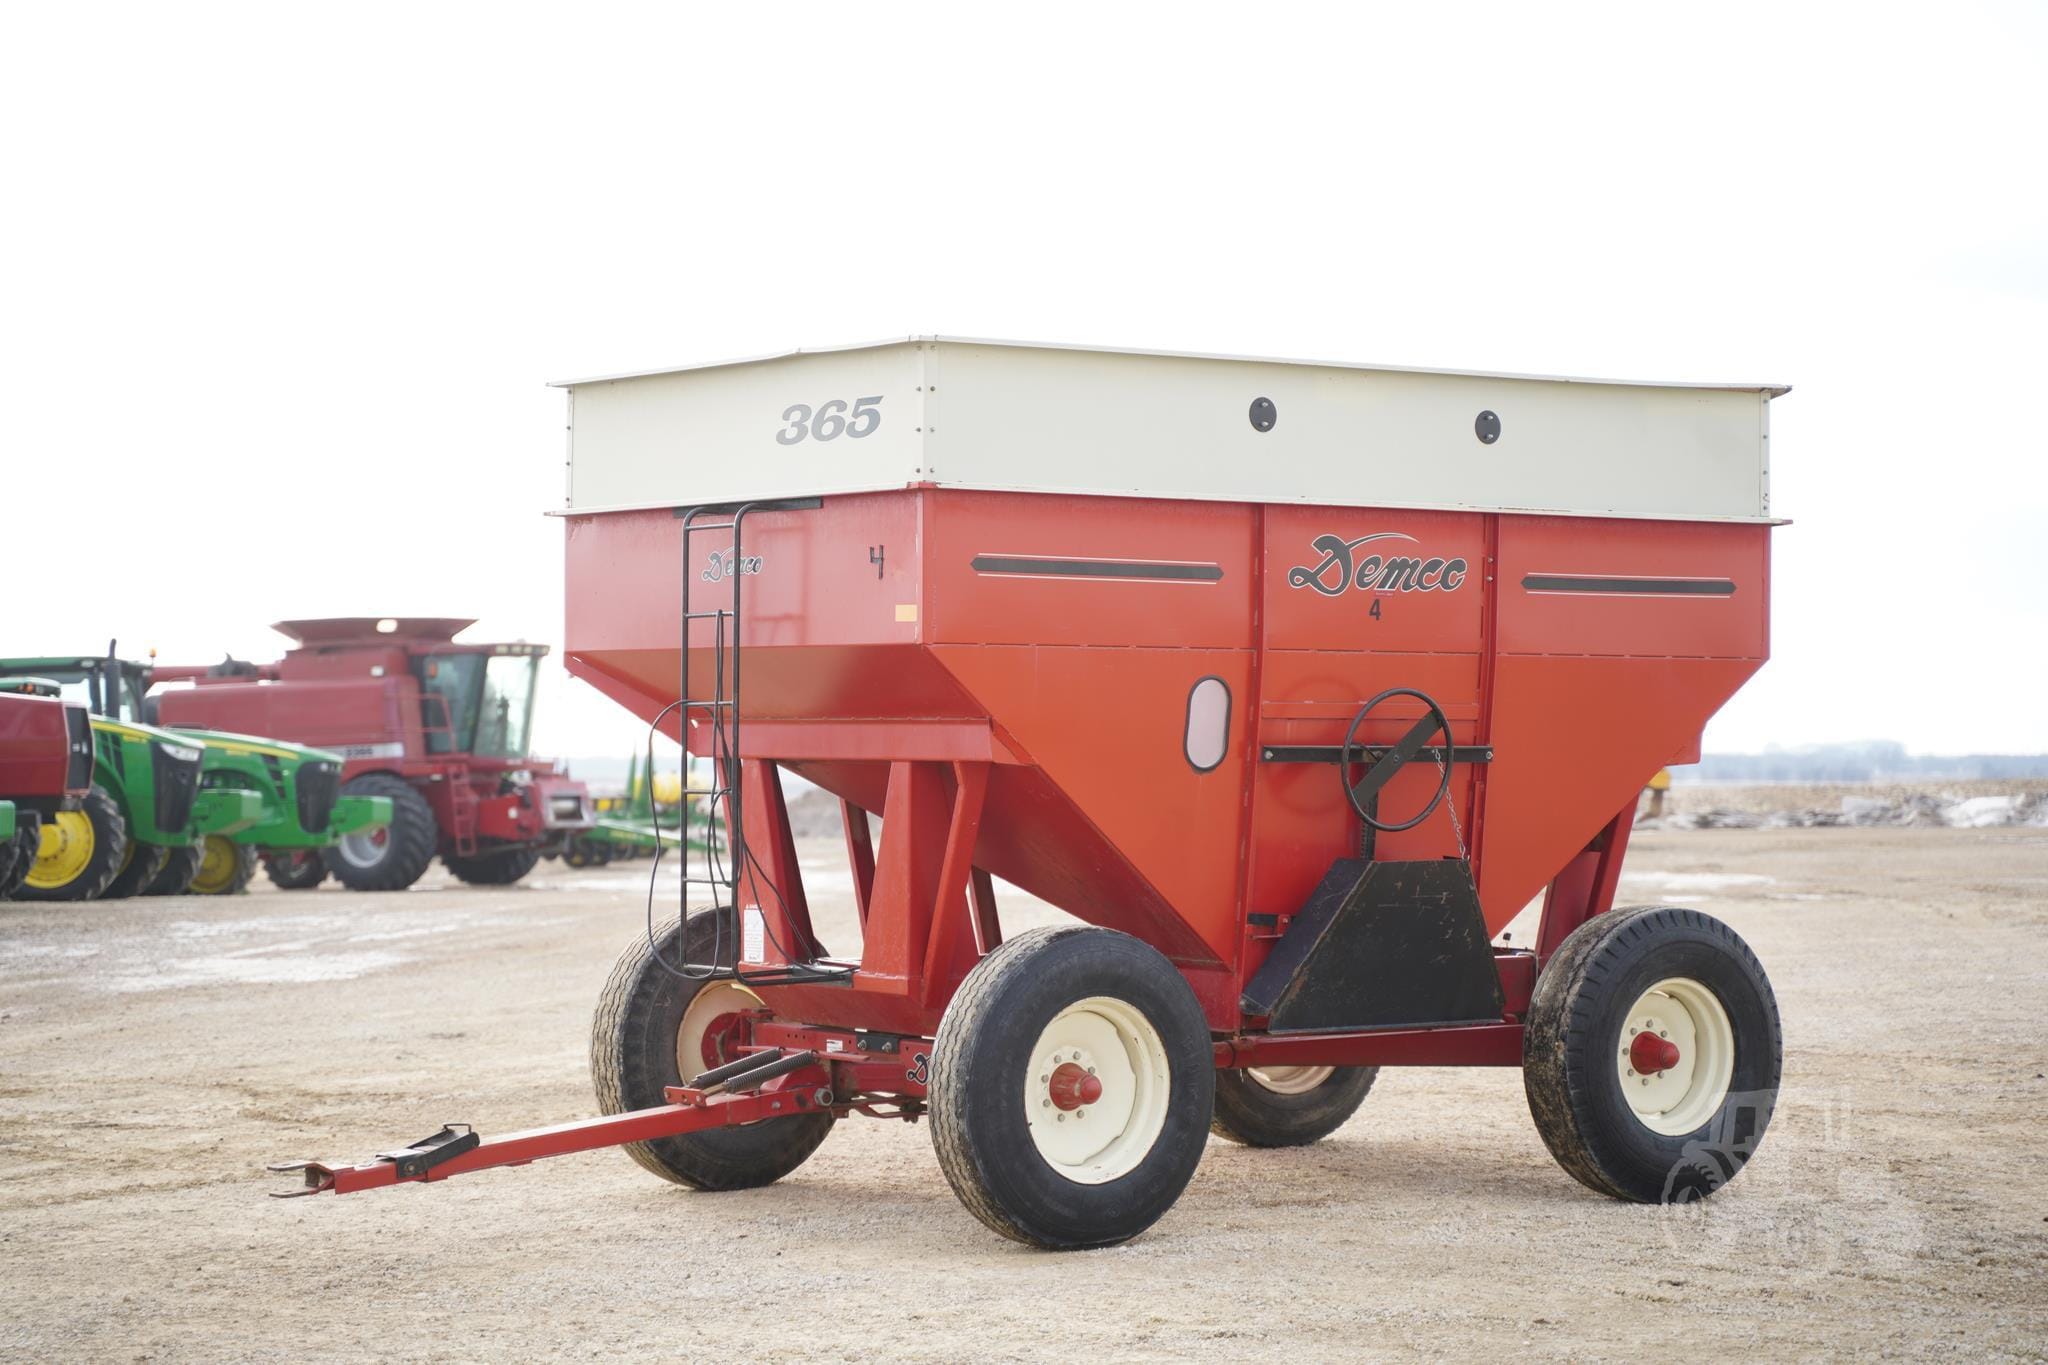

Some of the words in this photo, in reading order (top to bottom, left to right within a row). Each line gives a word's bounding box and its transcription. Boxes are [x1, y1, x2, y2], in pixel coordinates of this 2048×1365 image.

[776, 395, 884, 446] 365
[869, 544, 884, 580] 4
[1288, 532, 1468, 597] Demco
[1368, 599, 1381, 621] 4
